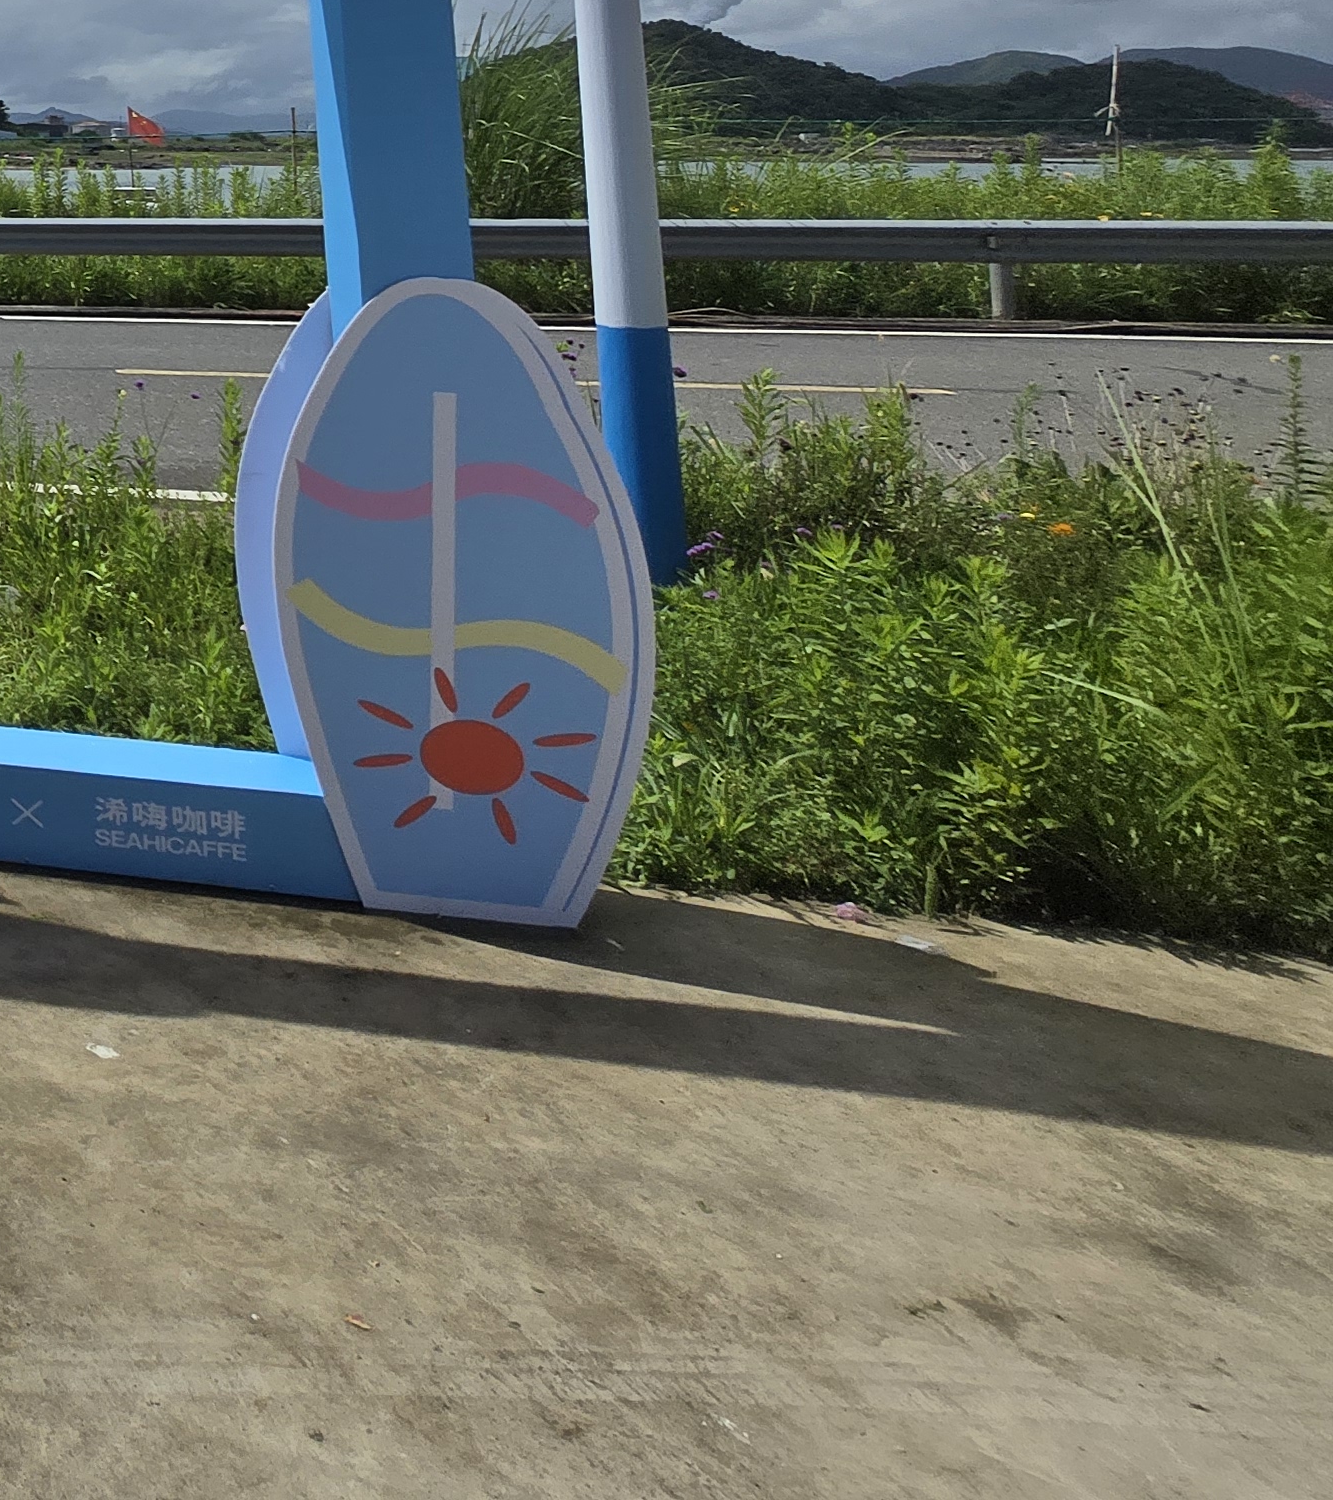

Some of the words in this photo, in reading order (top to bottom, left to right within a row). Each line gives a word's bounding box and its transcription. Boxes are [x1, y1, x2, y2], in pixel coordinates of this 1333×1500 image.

[94, 795, 247, 840] 浠嗨咖啡
[94, 828, 248, 863] SEAHICAFFE
